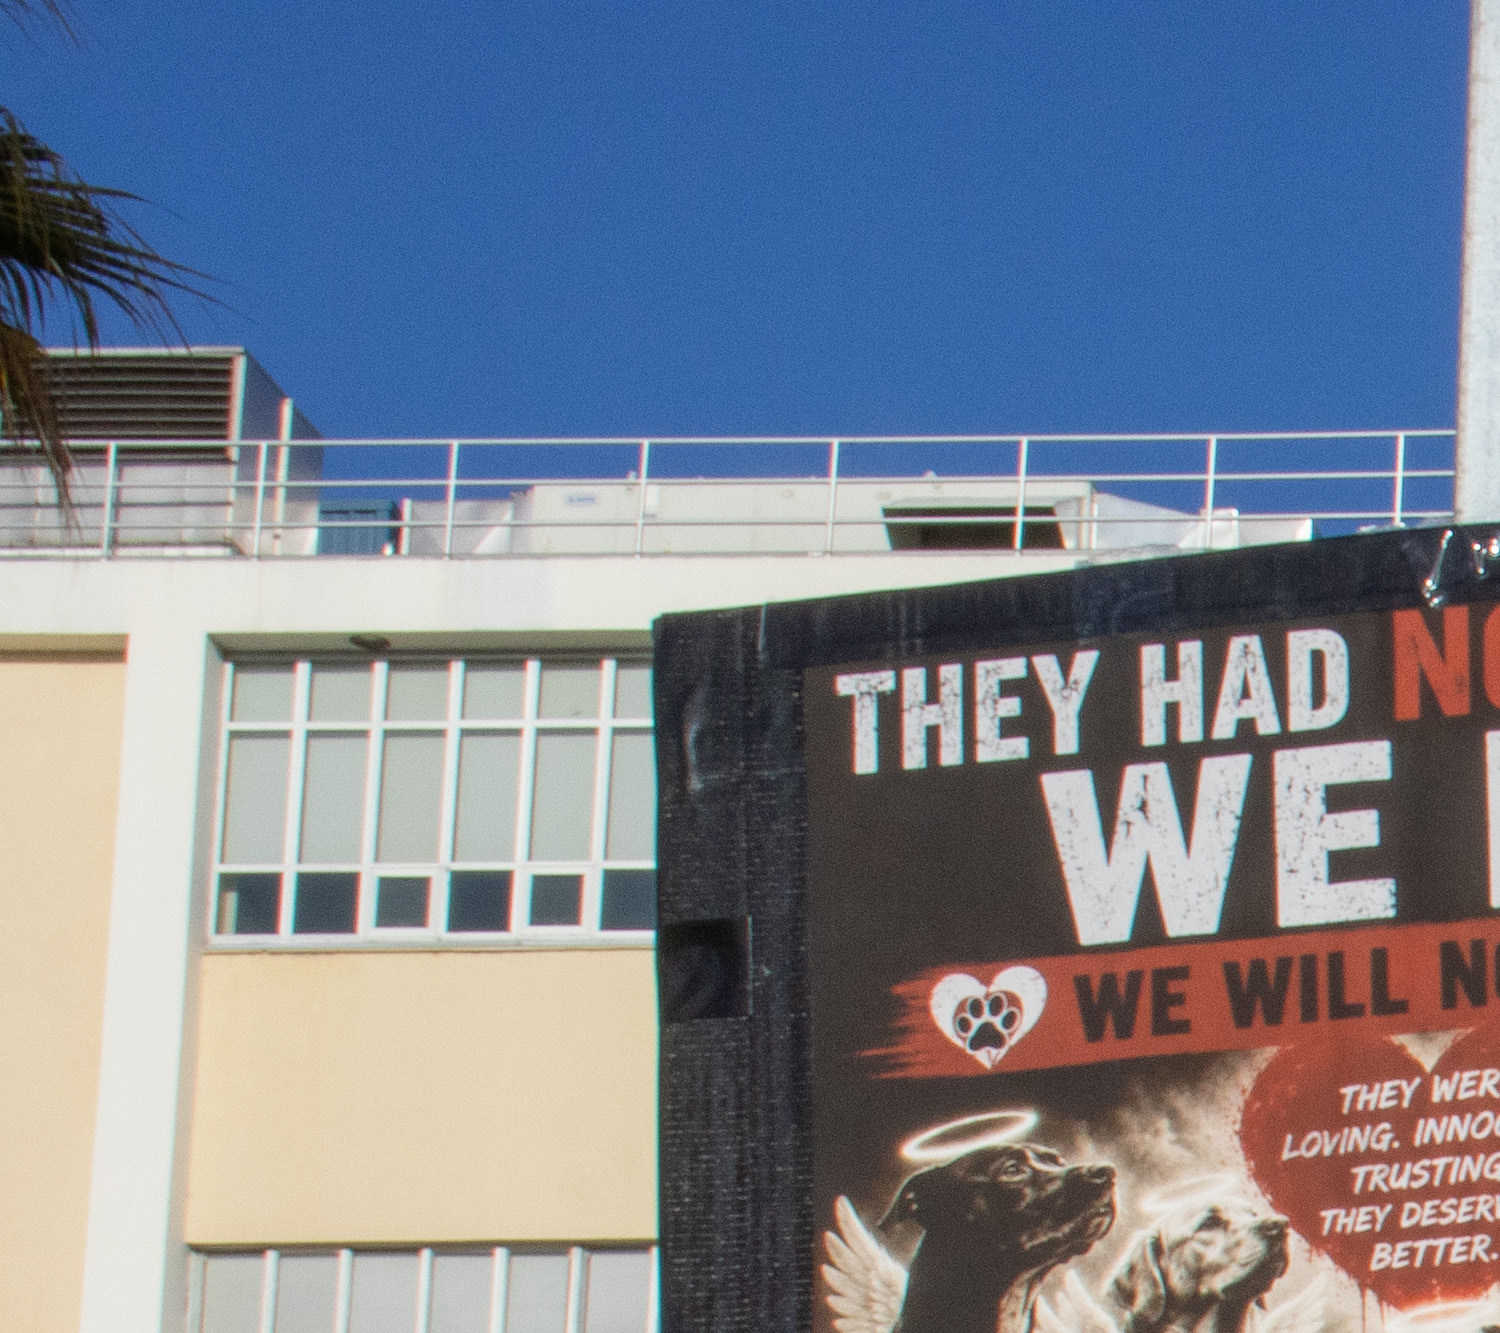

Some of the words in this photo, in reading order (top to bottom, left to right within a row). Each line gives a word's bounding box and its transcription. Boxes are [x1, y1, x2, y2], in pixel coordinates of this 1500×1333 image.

[836, 649, 1099, 775] THEY
[1142, 629, 1350, 745] HAD
[1042, 738, 1397, 947] WE
[1075, 965, 1188, 1044] WE
[1224, 948, 1408, 1029] WILL
[1339, 1077, 1421, 1114] THEY
[1282, 1122, 1399, 1161] LOVING.
[1321, 1205, 1393, 1236] THEY
[1370, 1235, 1499, 1272] BETTER.
